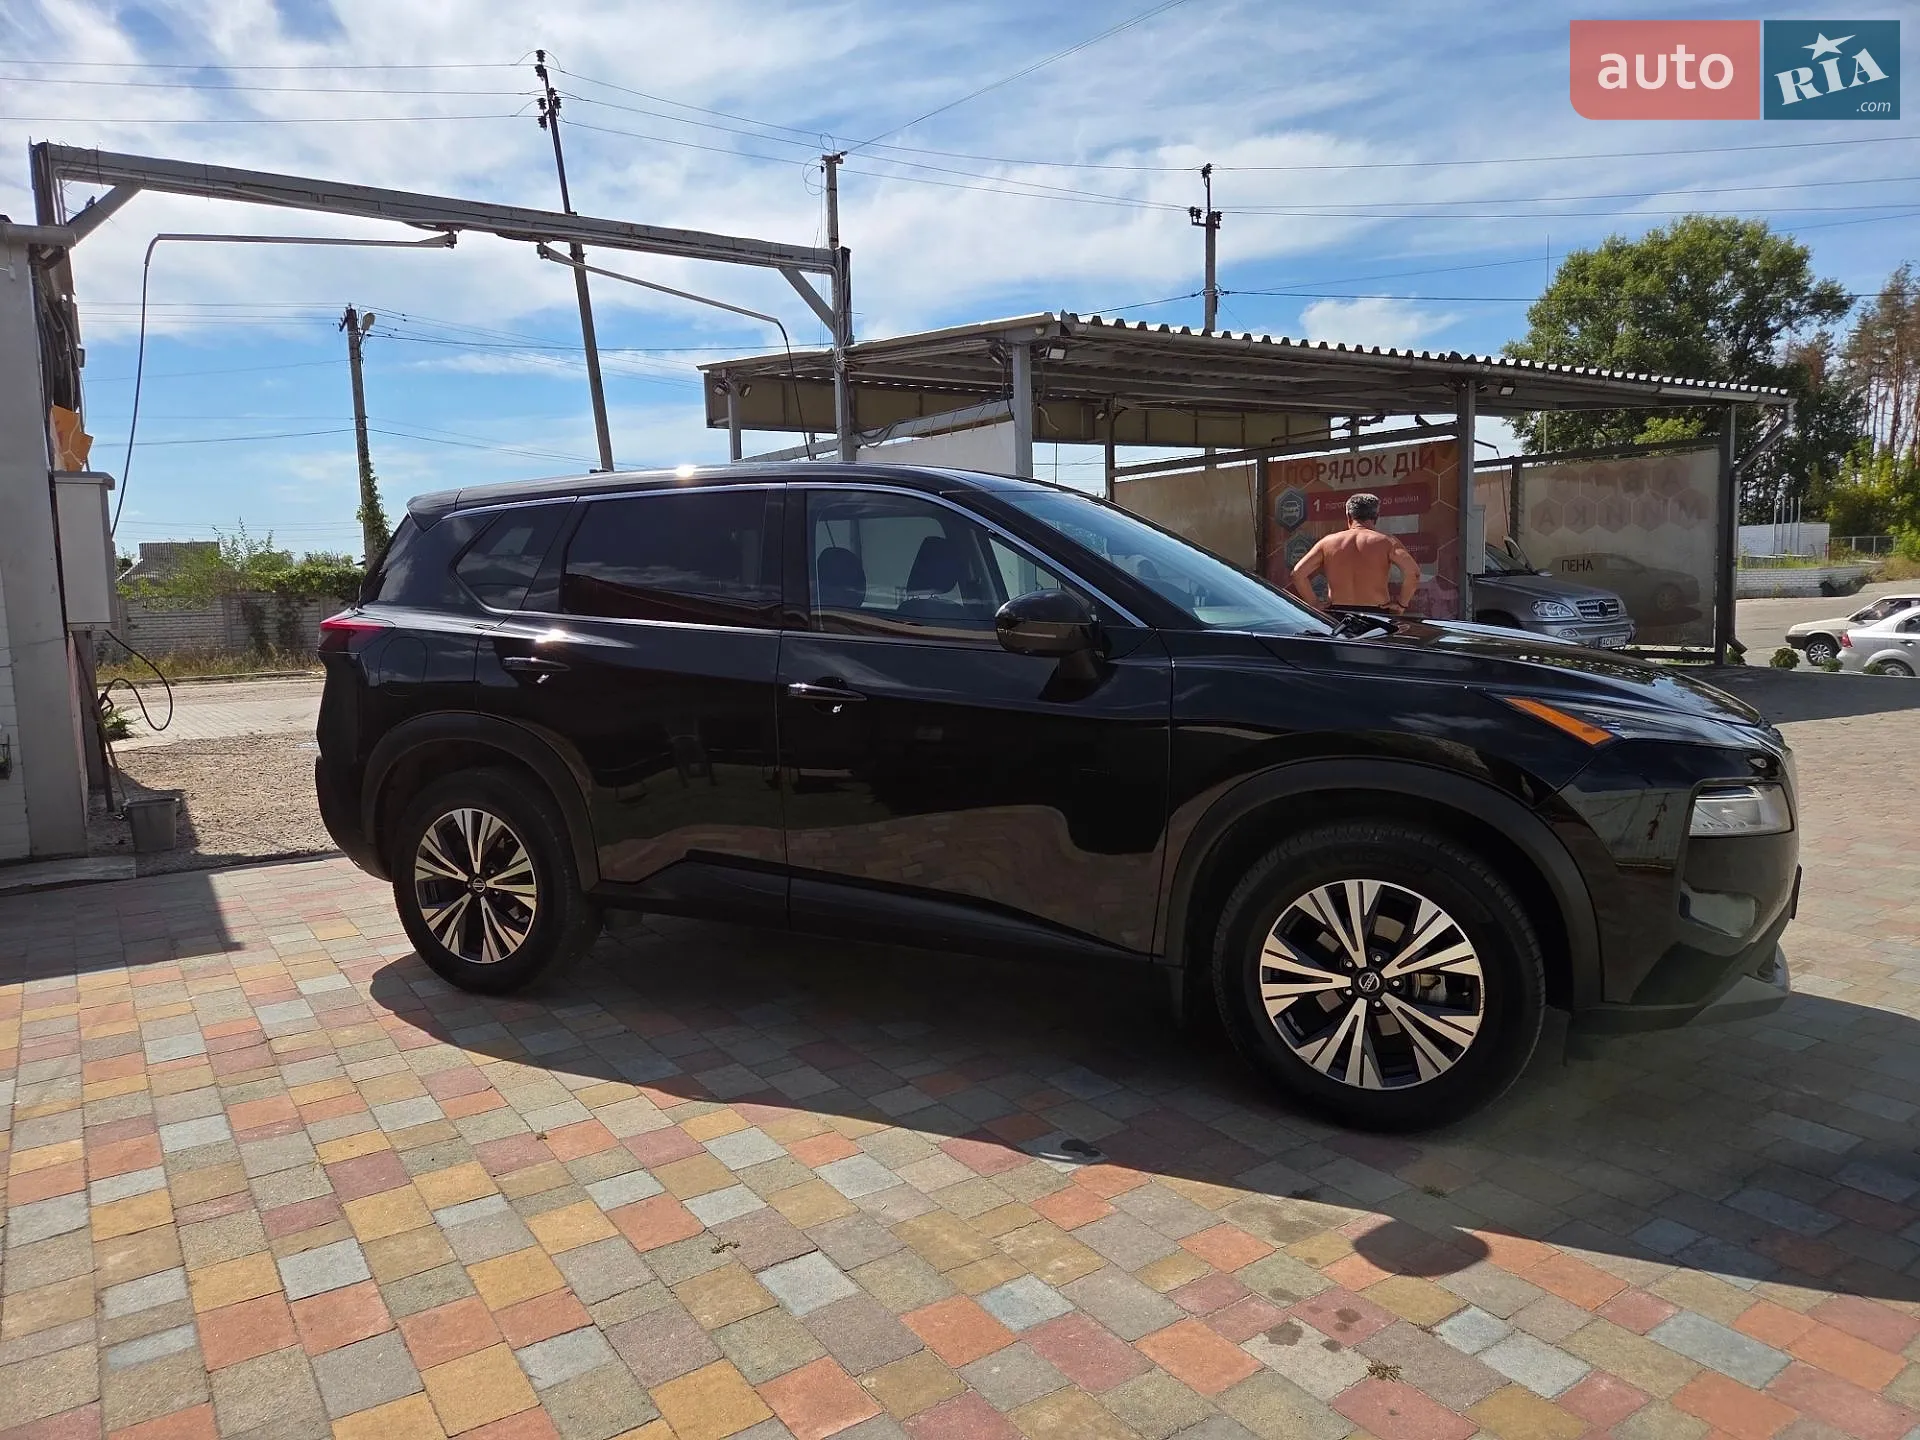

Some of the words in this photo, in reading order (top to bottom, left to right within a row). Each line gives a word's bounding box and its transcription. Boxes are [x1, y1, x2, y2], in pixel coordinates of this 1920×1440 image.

[1286, 454, 1387, 485] ПОРЯДОК
[1313, 499, 1321, 512] 1
[1560, 559, 1594, 573] ПЕНА
